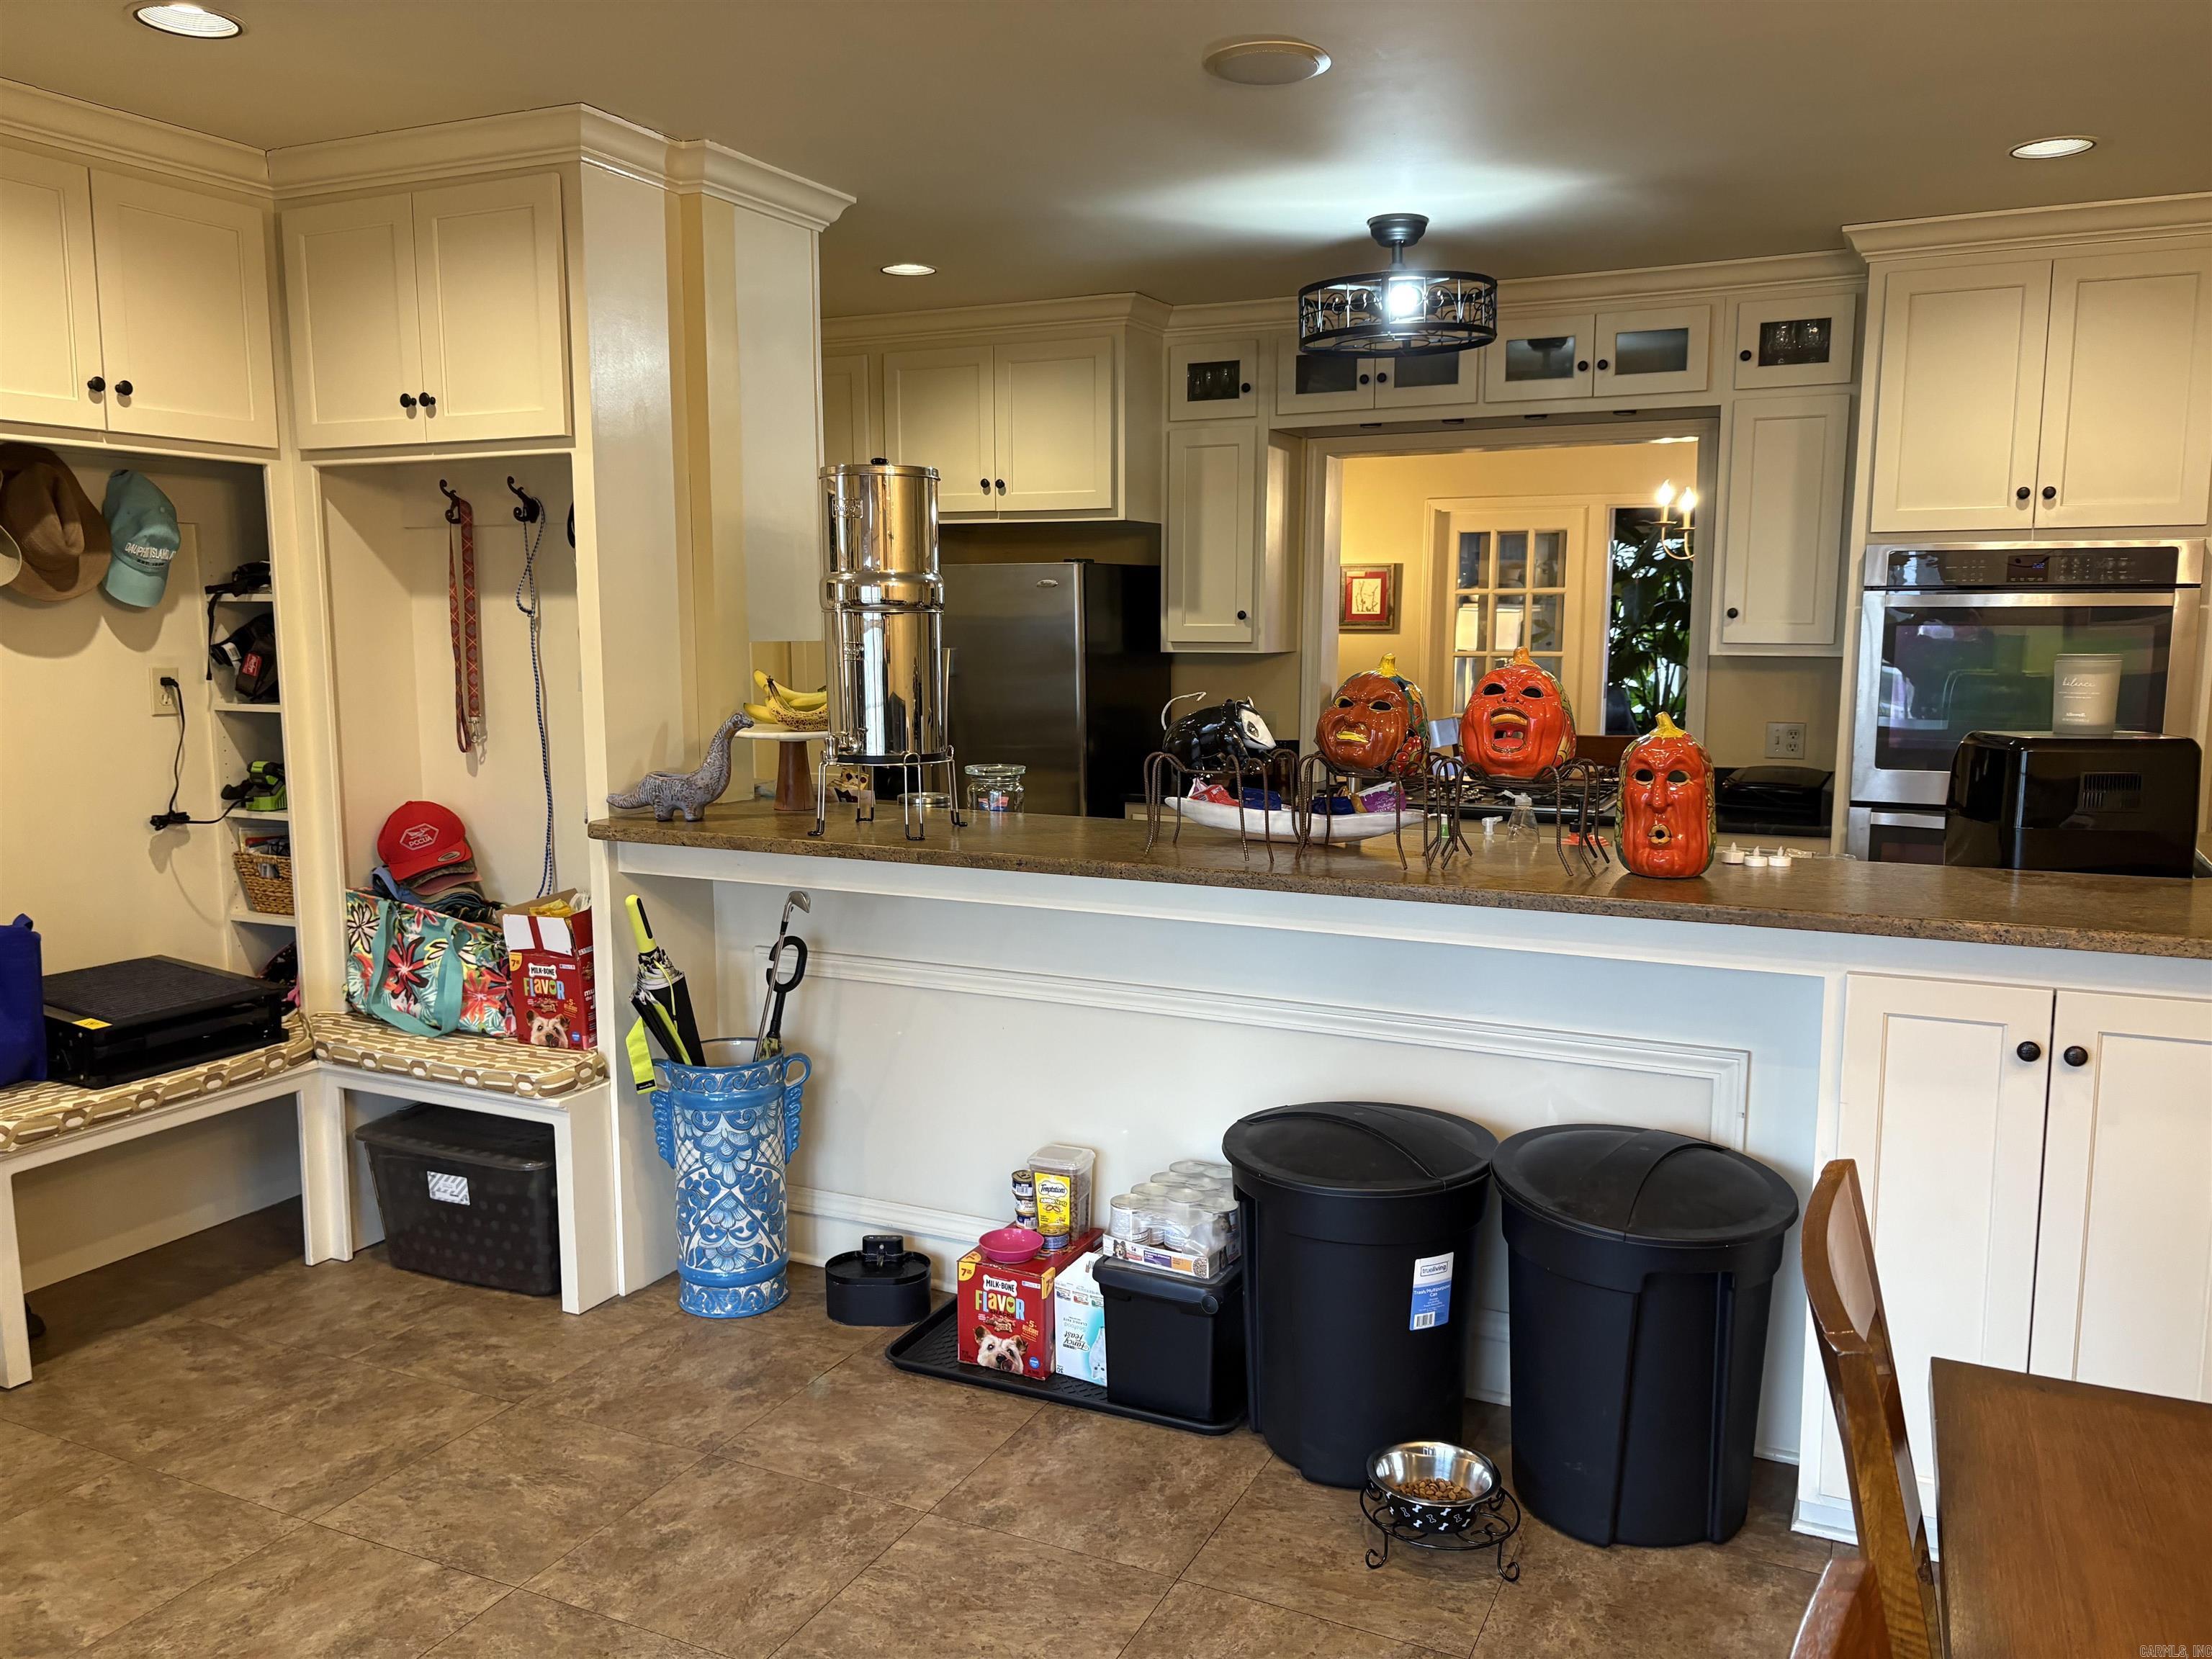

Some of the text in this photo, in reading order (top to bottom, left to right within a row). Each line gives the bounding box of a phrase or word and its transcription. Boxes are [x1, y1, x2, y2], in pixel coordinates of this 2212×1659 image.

[408, 836, 432, 847] PCCUA
[1041, 1184, 1066, 1194] Temptations
[1064, 1331, 1085, 1344] Feast
[1063, 1337, 1089, 1352] Fancy
